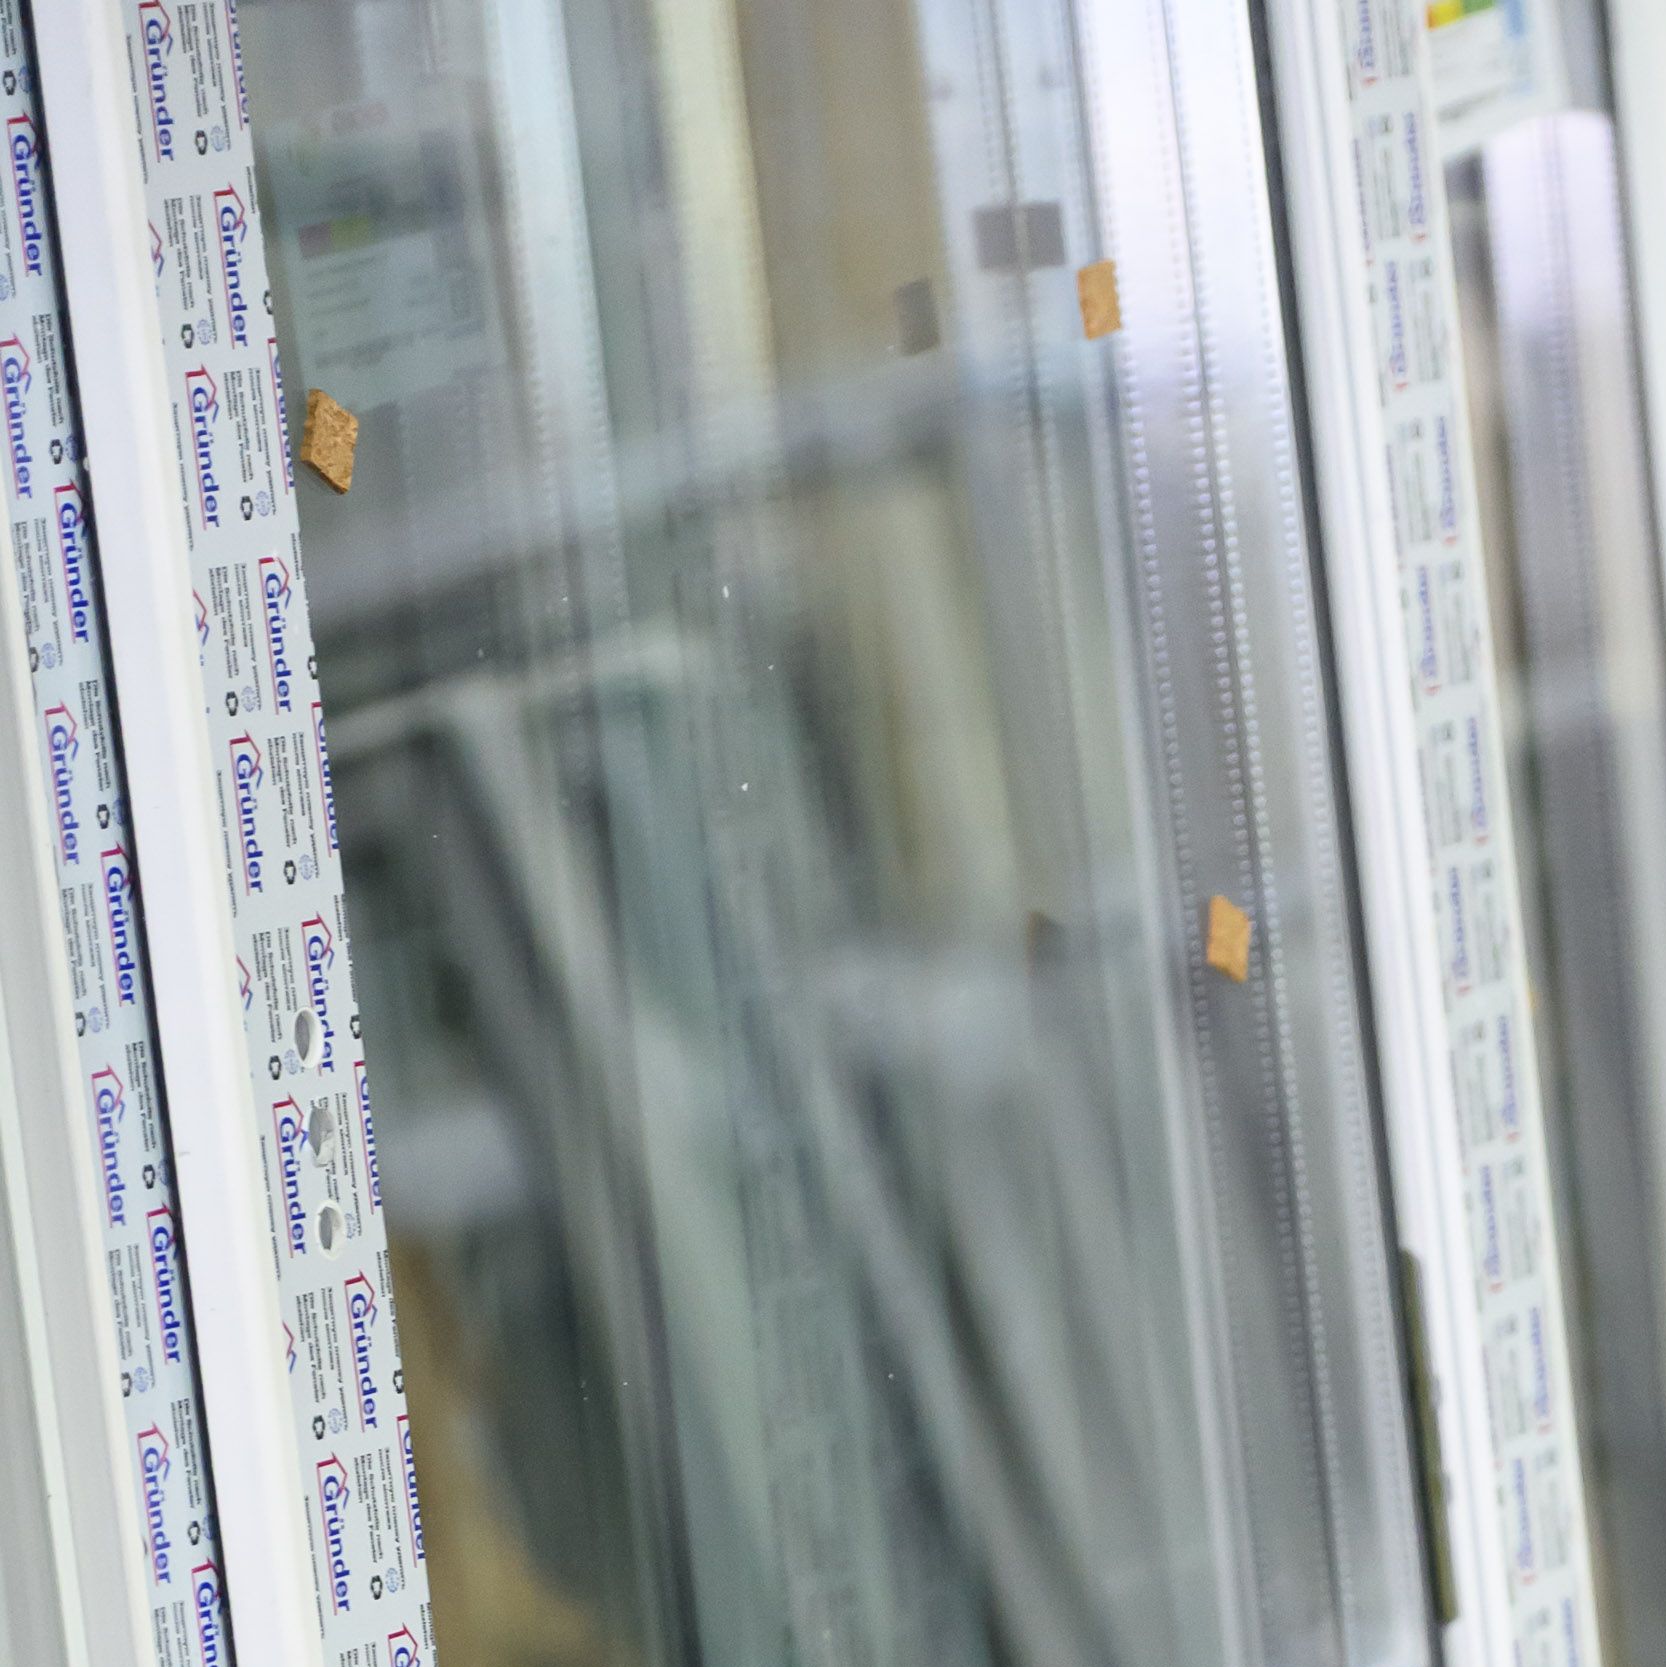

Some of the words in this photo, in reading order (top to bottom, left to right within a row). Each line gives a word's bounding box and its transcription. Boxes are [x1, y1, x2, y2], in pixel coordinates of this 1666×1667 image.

[147, 18, 176, 159] Gründer
[13, 133, 43, 278] Gründer
[221, 205, 248, 347] Gründer
[3, 355, 33, 500] Gründer
[192, 386, 221, 526] Gründer
[61, 501, 91, 645] Gründer
[266, 572, 293, 711] Gründer
[50, 723, 81, 866] Gründer
[236, 753, 264, 891] Gründer
[107, 864, 136, 1006] Gründer
[97, 1088, 128, 1226] Gründer
[280, 1116, 306, 1254] Gründer
[153, 1224, 181, 1365] Gründer
[352, 1292, 379, 1427] Gründer
[144, 1447, 173, 1585] Gründer
[324, 1475, 352, 1611] Gründer
